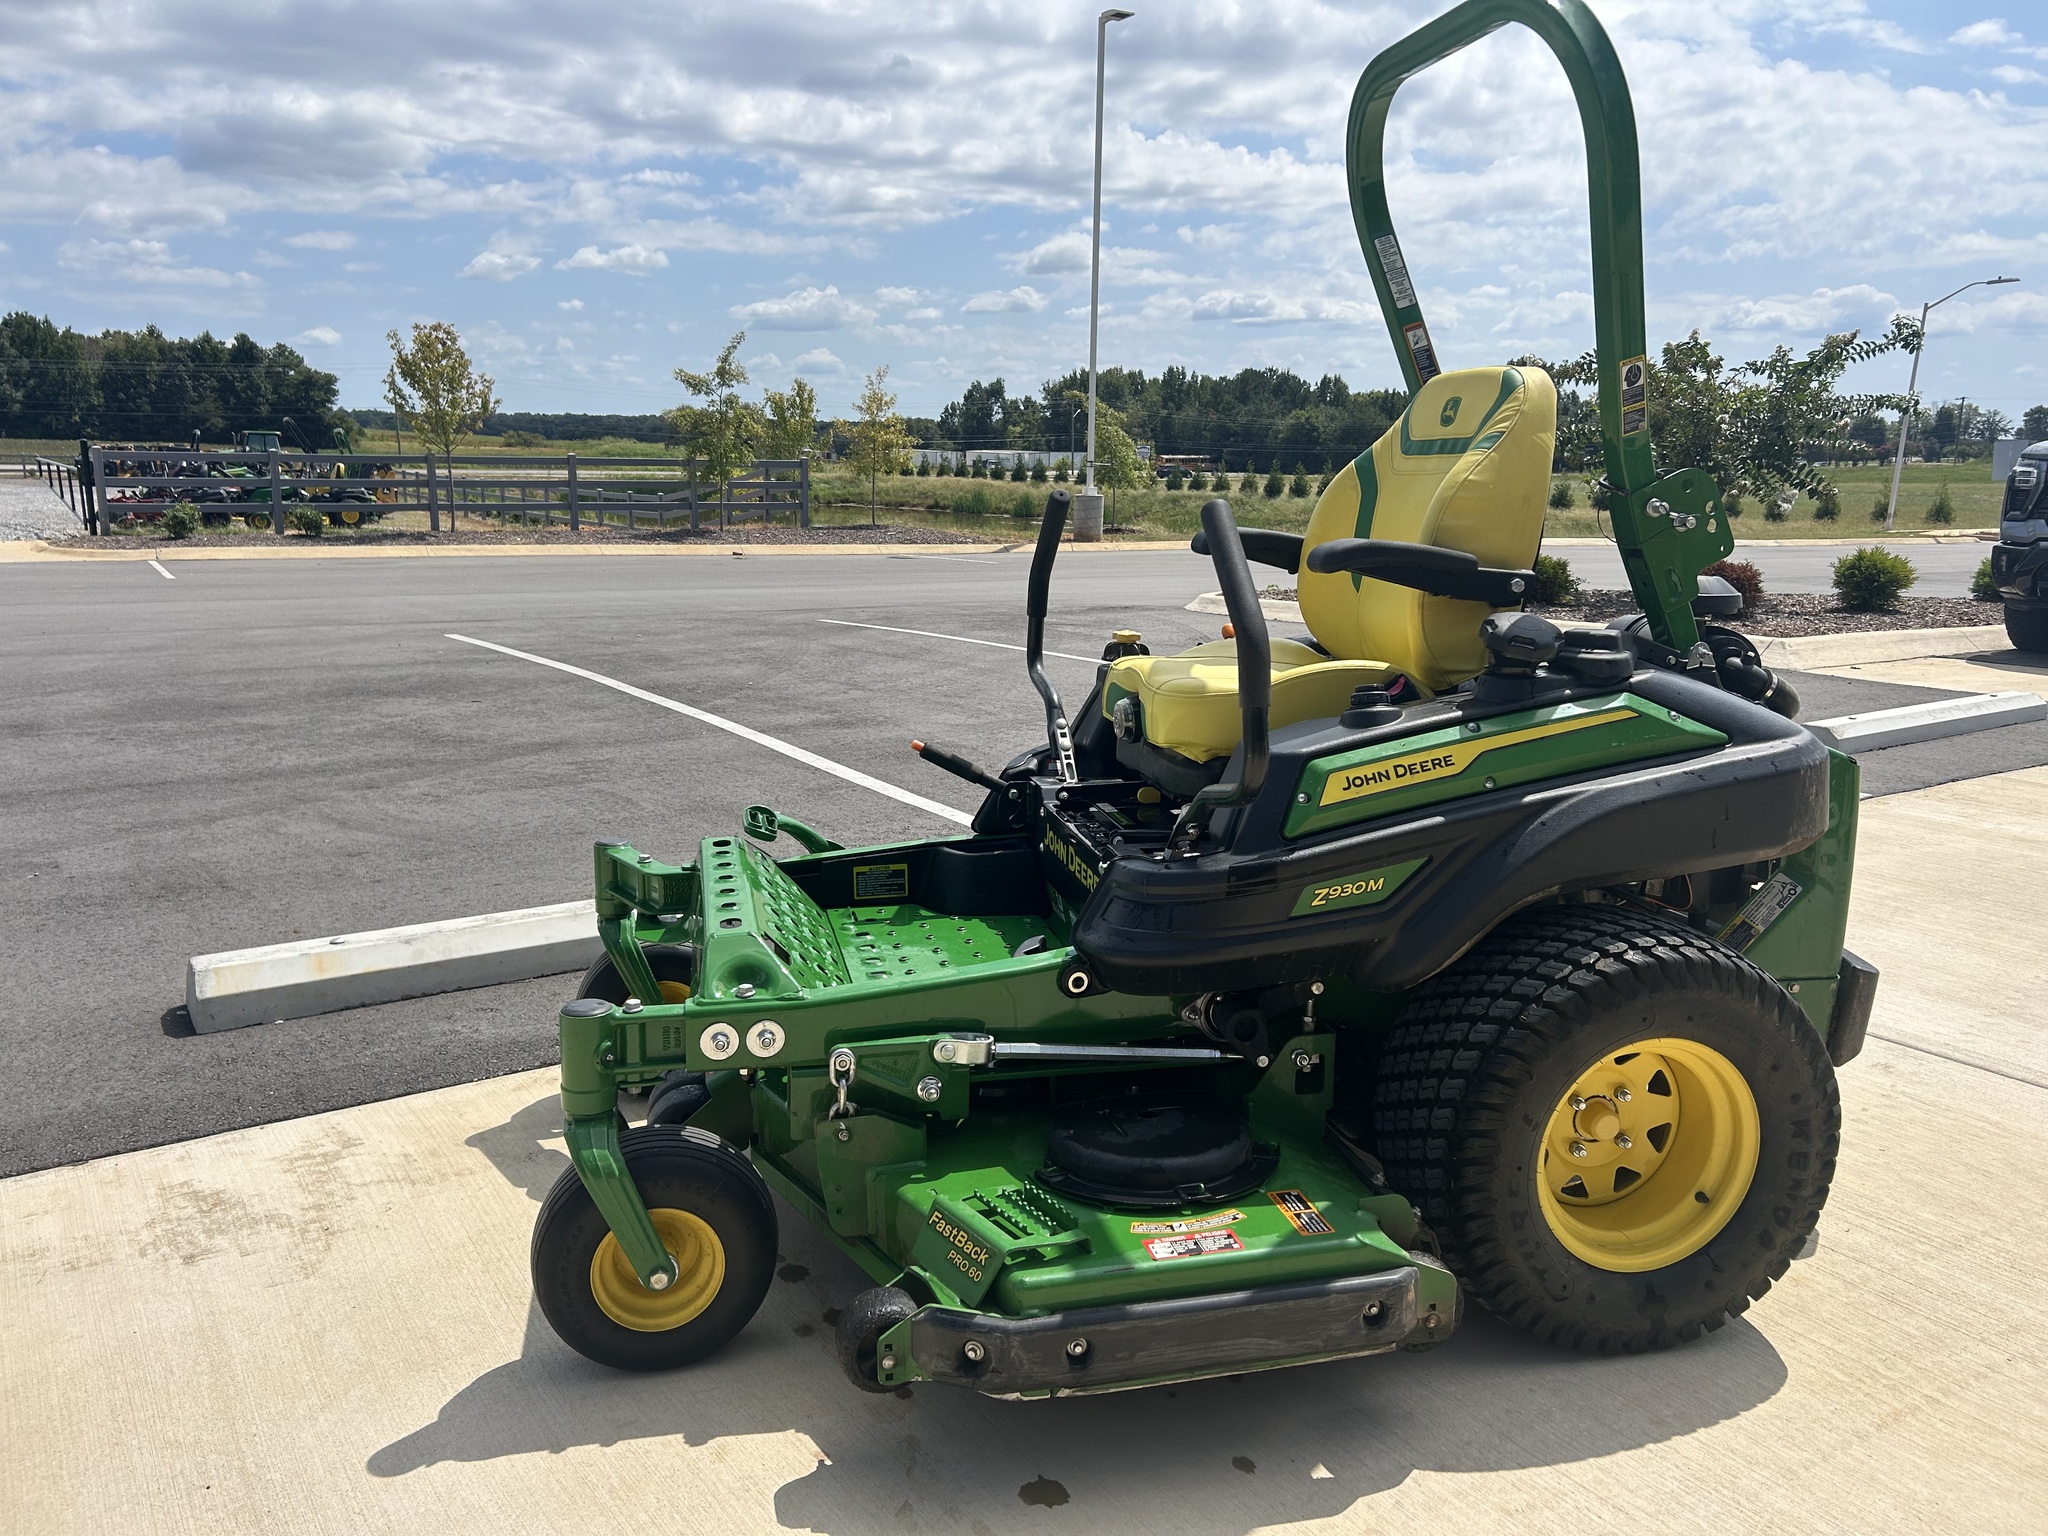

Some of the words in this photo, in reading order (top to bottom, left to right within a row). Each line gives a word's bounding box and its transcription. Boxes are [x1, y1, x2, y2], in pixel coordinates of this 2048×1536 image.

[1342, 769, 1391, 792] JOHN
[1393, 754, 1456, 779] DEERE
[1044, 822, 1067, 865] JOHN
[1310, 877, 1385, 907] Z930M
[928, 1210, 989, 1266] FastBack
[946, 1249, 969, 1271] PRO
[968, 1266, 982, 1282] 60
